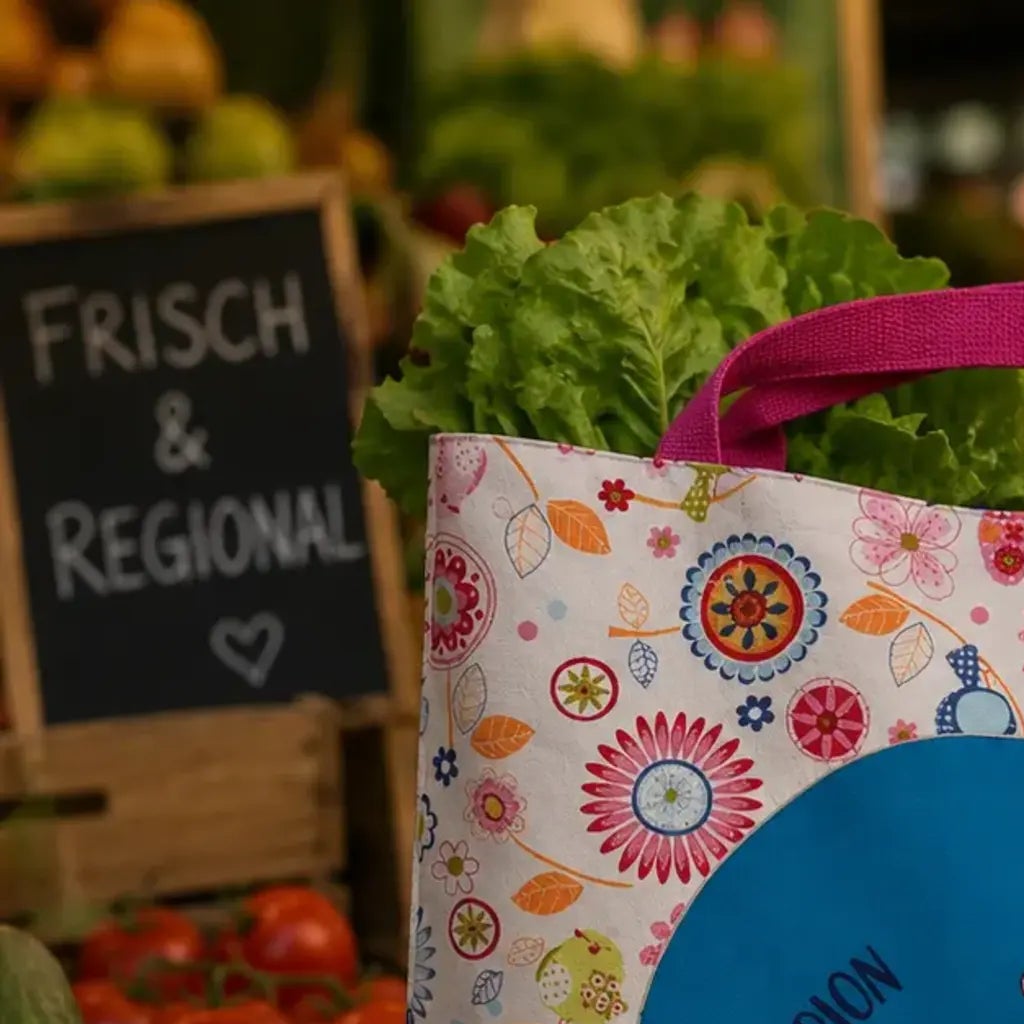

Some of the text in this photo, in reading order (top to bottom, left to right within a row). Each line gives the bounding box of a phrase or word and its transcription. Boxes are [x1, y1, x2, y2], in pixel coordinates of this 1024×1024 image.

[22, 271, 310, 384] FRISCH
[153, 389, 211, 474] &
[45, 484, 366, 600] REGIONAL
